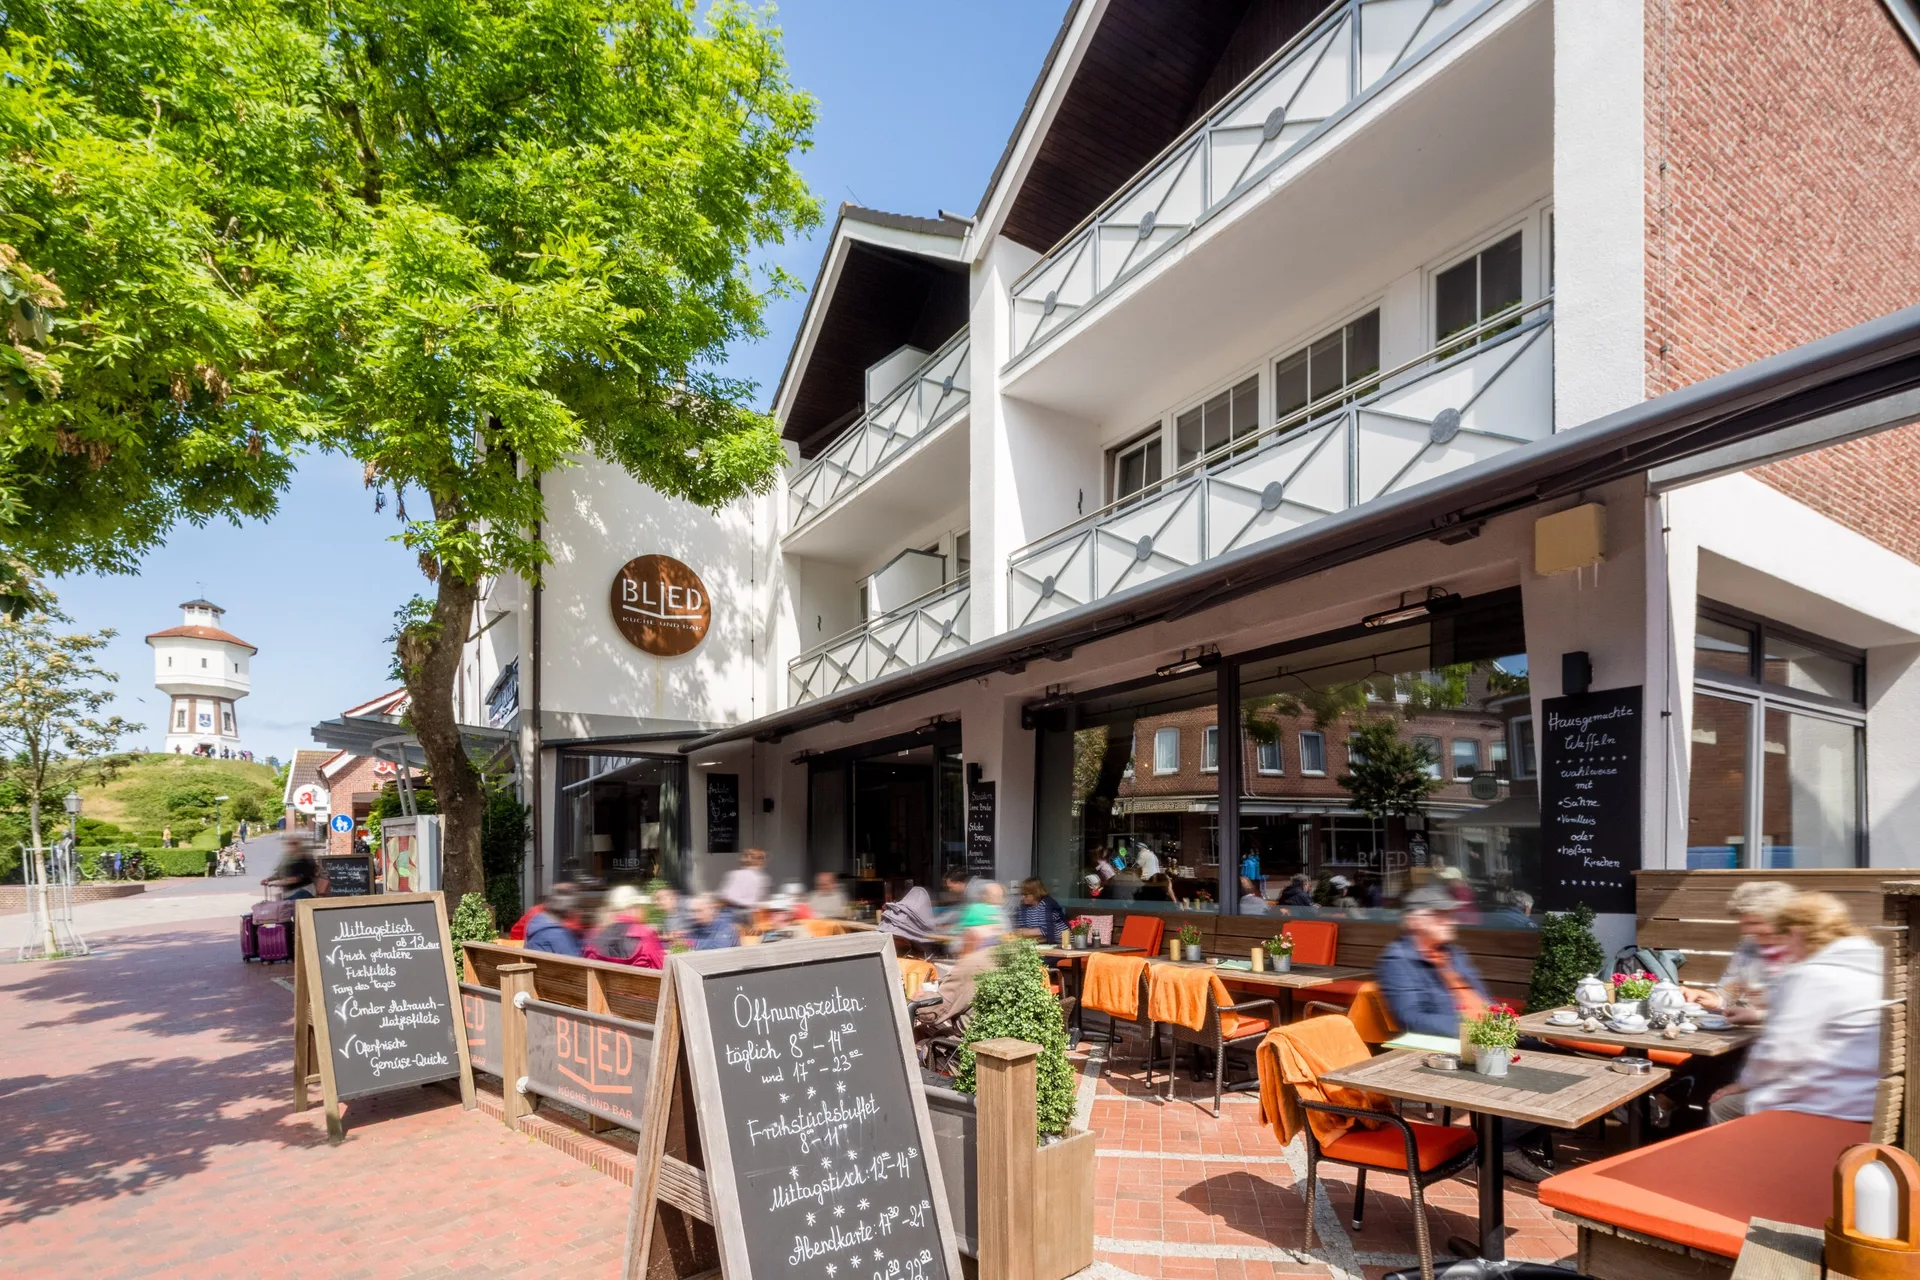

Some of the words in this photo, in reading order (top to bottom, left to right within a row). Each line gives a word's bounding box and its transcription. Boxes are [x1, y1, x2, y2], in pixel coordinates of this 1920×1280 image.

[622, 578, 702, 612] BLIED
[660, 621, 680, 629] UND
[1548, 705, 1634, 733] Hausgemachte
[1564, 733, 1616, 752] Waffeln
[1560, 766, 1618, 778] wahlweise
[1575, 779, 1593, 789] mit
[1562, 797, 1600, 808] Sahne
[1570, 831, 1595, 842] oder
[1583, 856, 1621, 868] Kirschen
[334, 917, 415, 941] Mittagstisch
[396, 936, 407, 948] ab
[339, 948, 367, 968] frisch
[370, 946, 413, 963] gebratene
[332, 984, 354, 996] Fang
[354, 982, 370, 992] des
[349, 999, 385, 1018] Emder
[734, 985, 867, 1036] Öffnungszeiten:
[354, 1037, 408, 1058] Ofenfrische
[556, 1015, 633, 1077] BLIED
[726, 1039, 782, 1074] täglich
[761, 1066, 785, 1084] und
[590, 1096, 610, 1112] UND
[612, 1104, 633, 1120] BAR
[746, 1092, 881, 1147] Frühstücksbuffet
